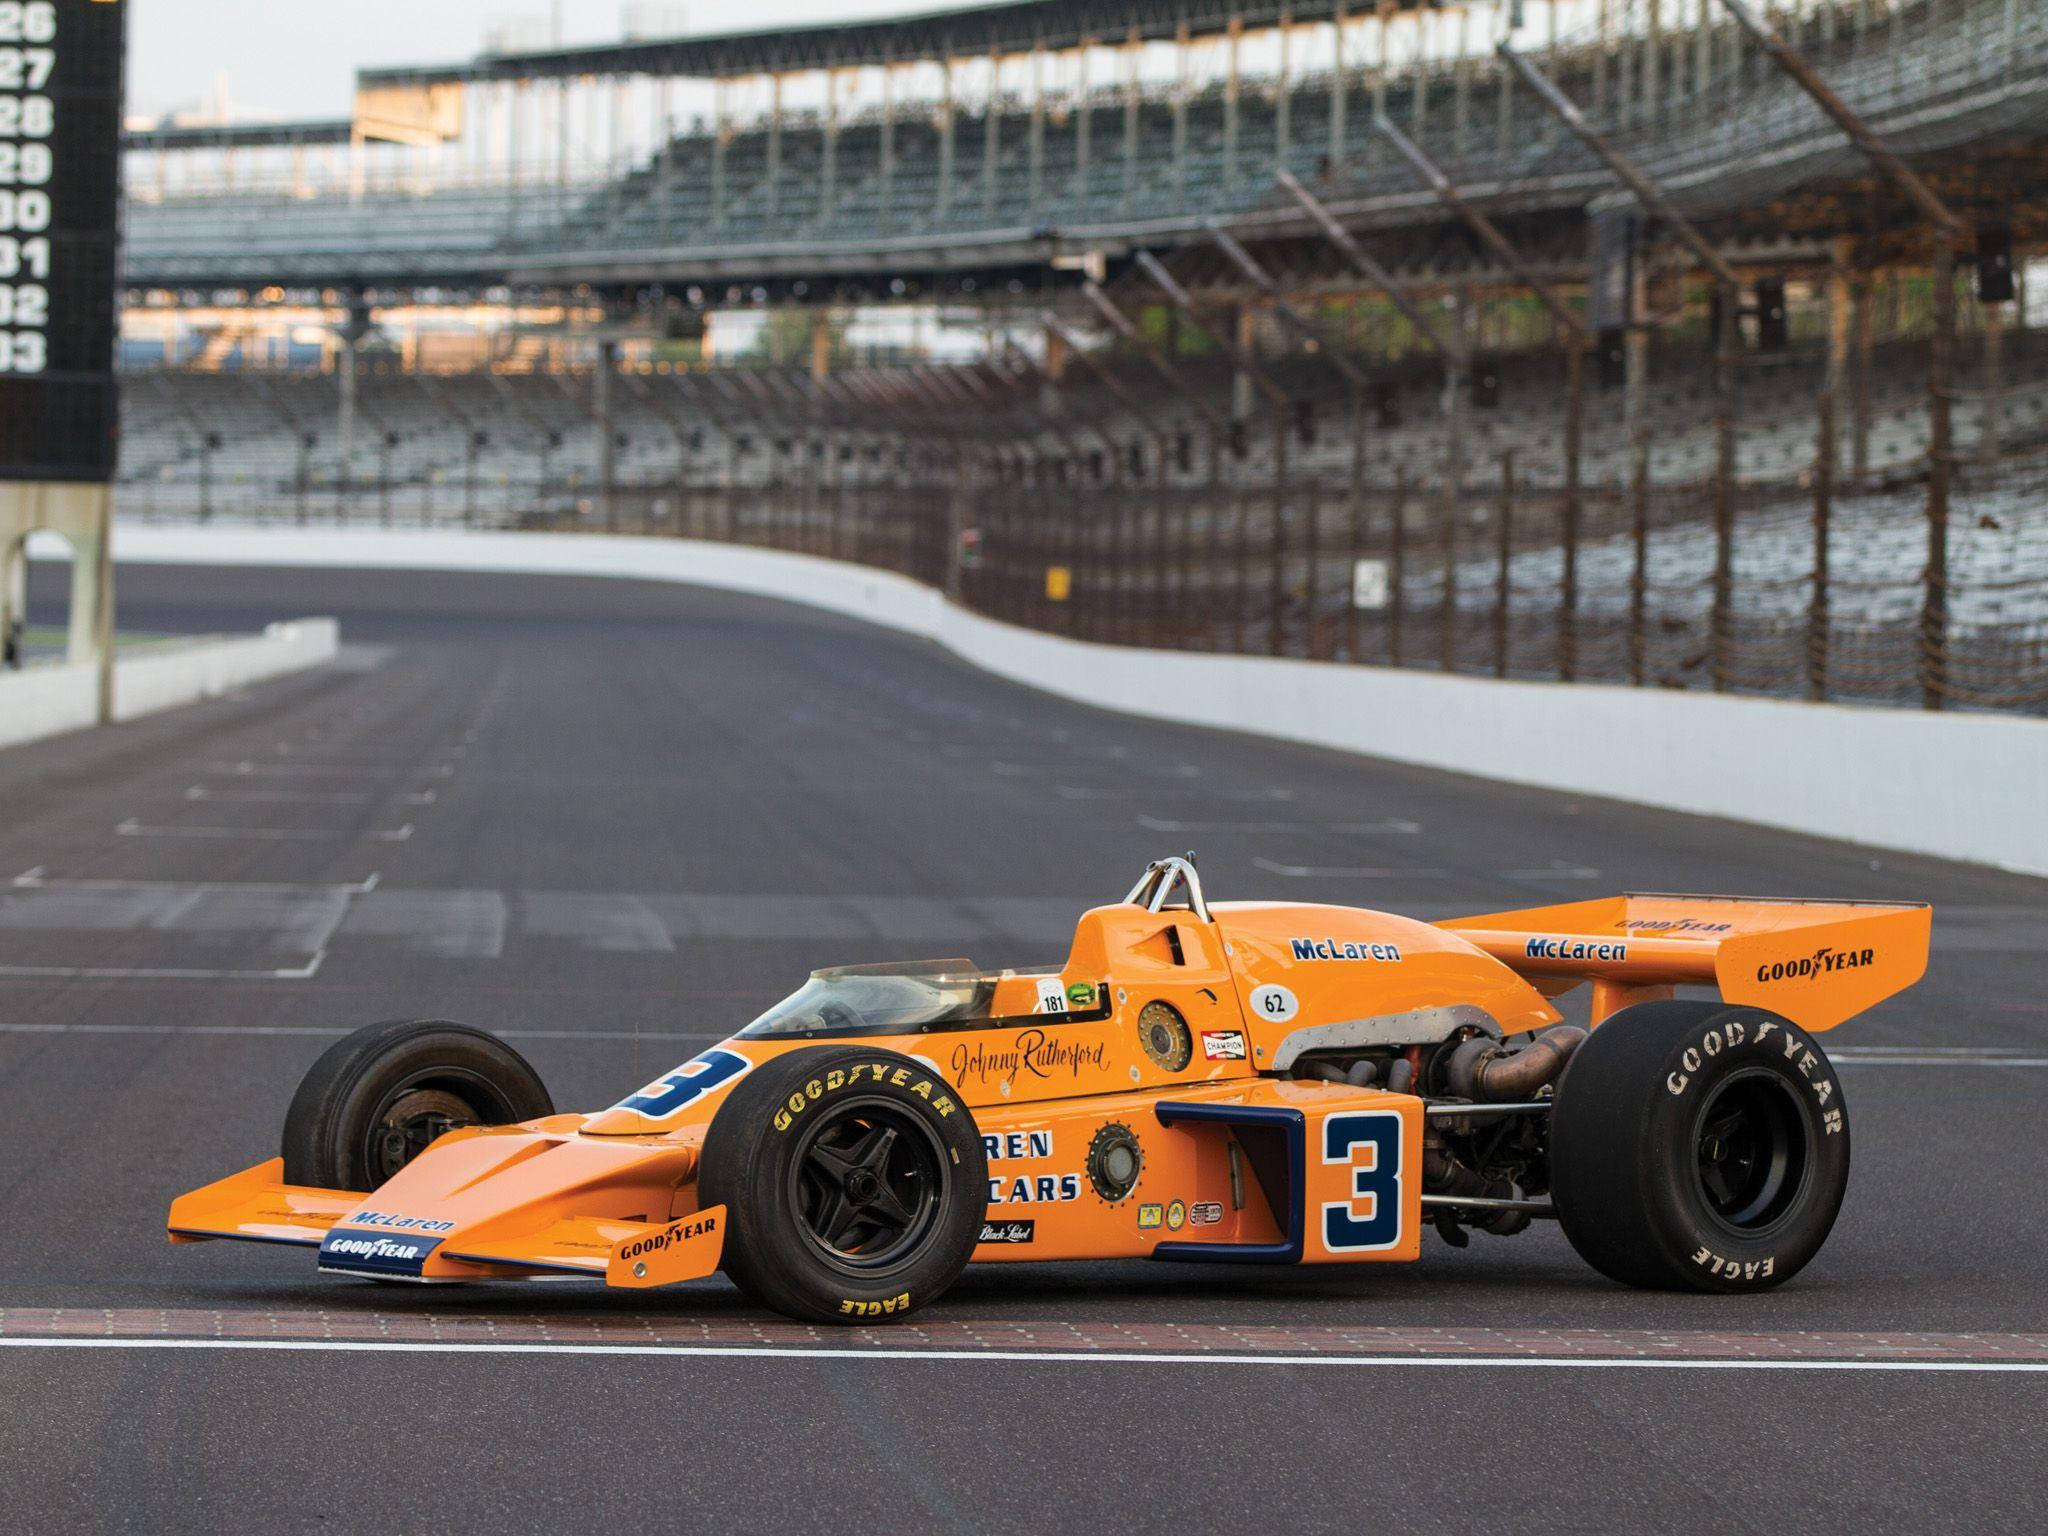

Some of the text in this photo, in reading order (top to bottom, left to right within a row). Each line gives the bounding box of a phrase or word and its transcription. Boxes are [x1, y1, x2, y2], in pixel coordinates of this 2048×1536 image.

[1290, 937, 1401, 961] McLaren
[1526, 937, 1627, 961] McLaren
[1757, 947, 1874, 982] GOODYEAR
[1045, 996, 1064, 1011] 181
[1264, 994, 1285, 1013] 62
[1207, 1041, 1242, 1051] CHAMPION
[952, 1029, 1110, 1088] Johnny Rutherford
[606, 1048, 753, 1120] 3
[1667, 1021, 1843, 1136] GOODYEAR
[773, 1063, 957, 1131] GOODYEAR
[1321, 1109, 1403, 1253] 3
[350, 1211, 455, 1231] McLaren
[979, 1223, 1031, 1242] Black Label
[329, 1238, 419, 1260] GOODYEAR
[620, 1217, 716, 1260] GOODYEAR
[1691, 1246, 1776, 1280] EAGLE
[839, 1292, 910, 1315] EAGLE
